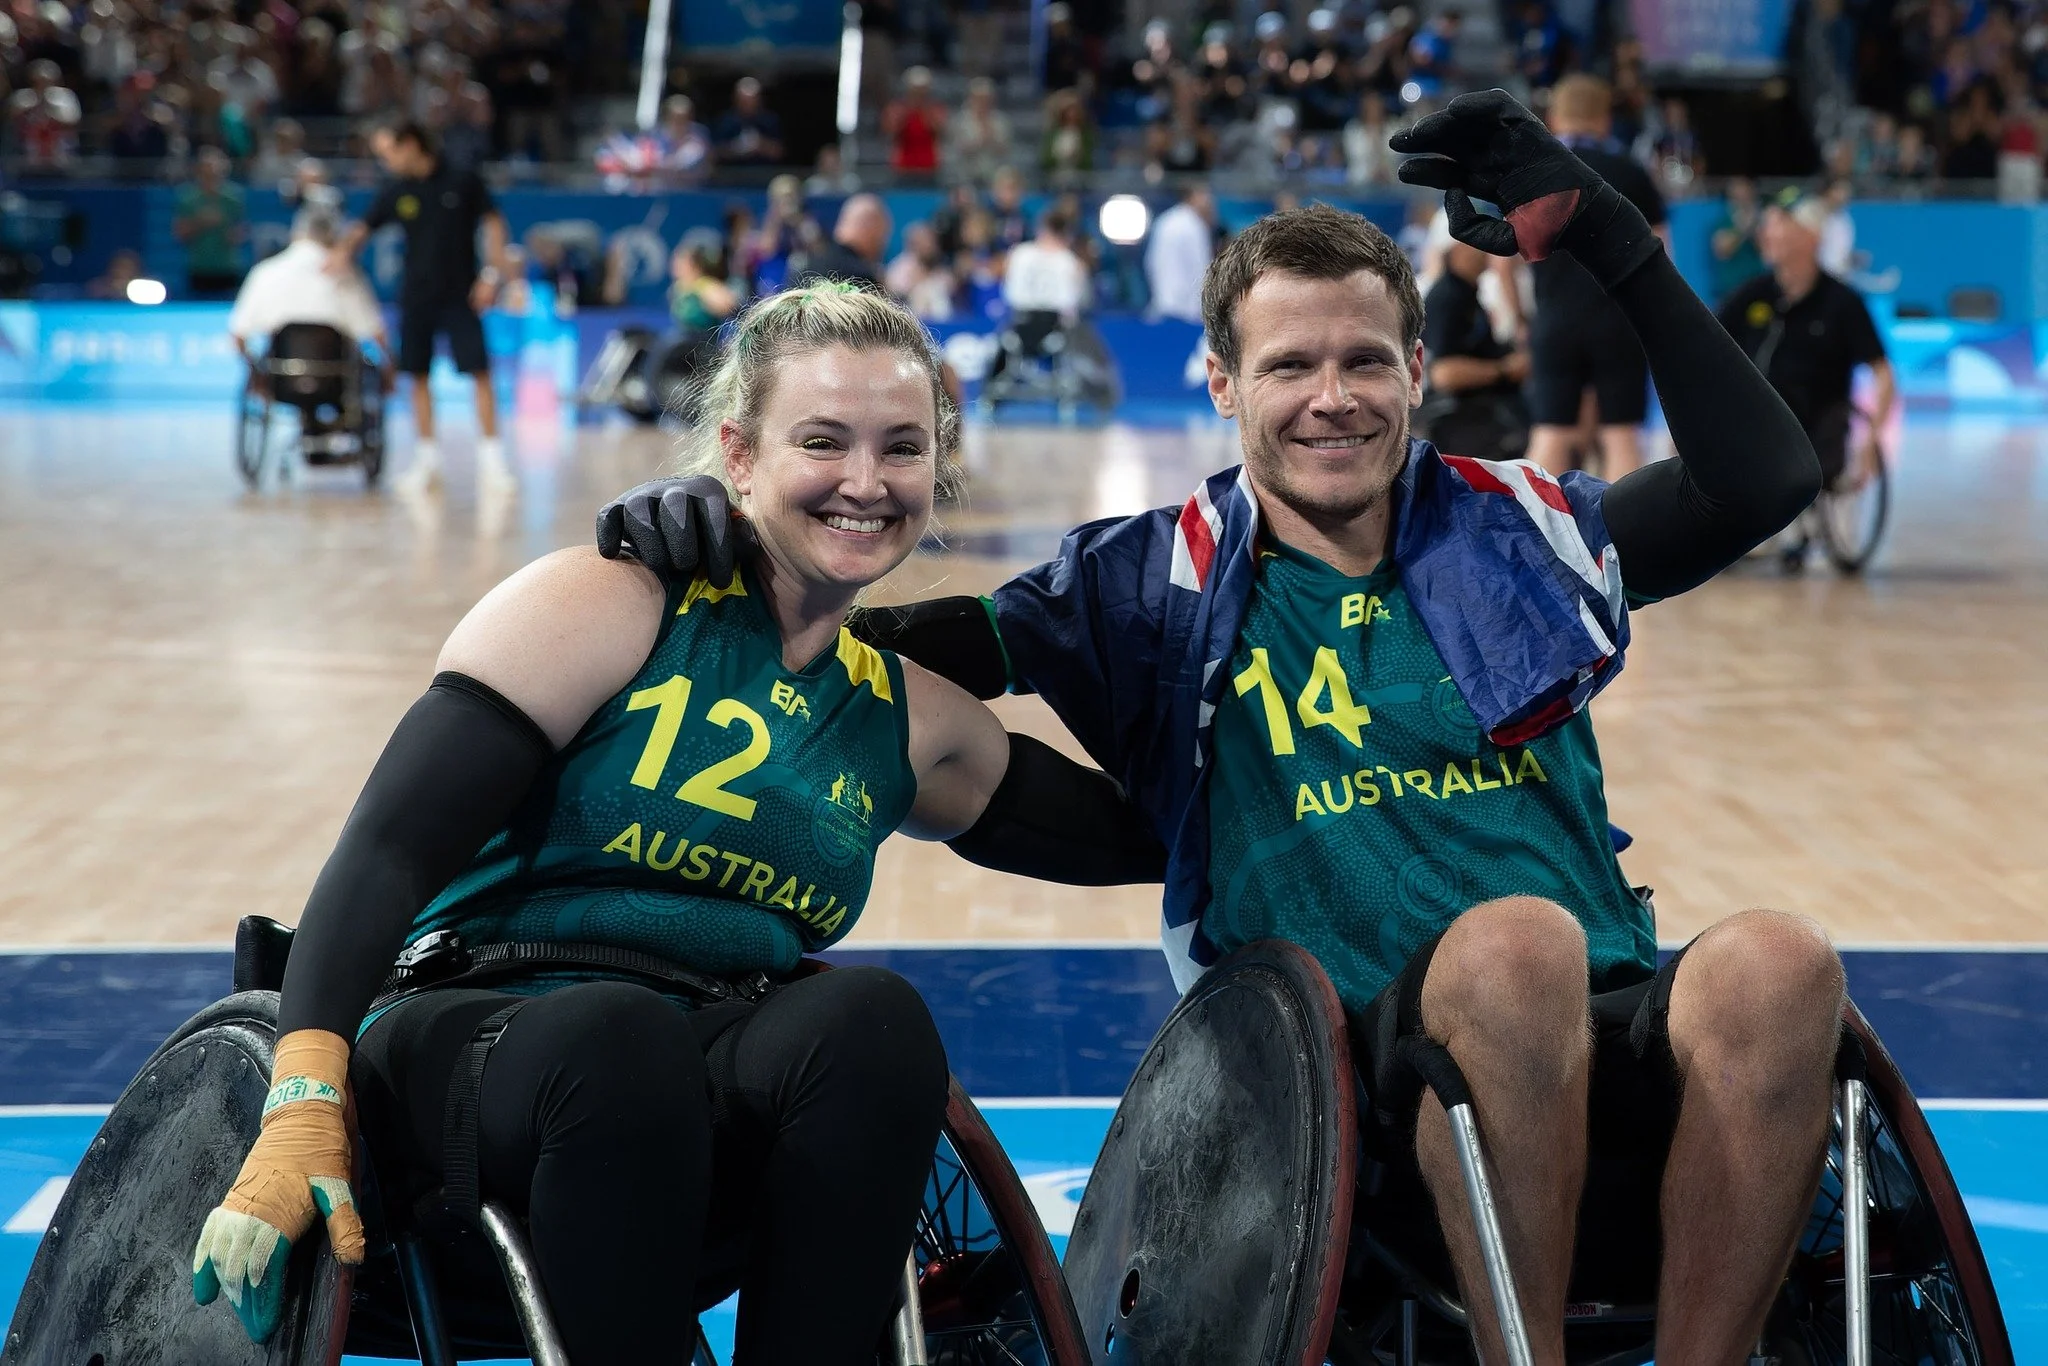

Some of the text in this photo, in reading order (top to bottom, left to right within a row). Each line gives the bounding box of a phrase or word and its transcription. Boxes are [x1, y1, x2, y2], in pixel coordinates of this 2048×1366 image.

[625, 674, 771, 822] 12
[1234, 645, 1372, 756] 14
[1295, 749, 1548, 821] AUSTRALIA
[601, 822, 848, 938] AUSTRALIA
